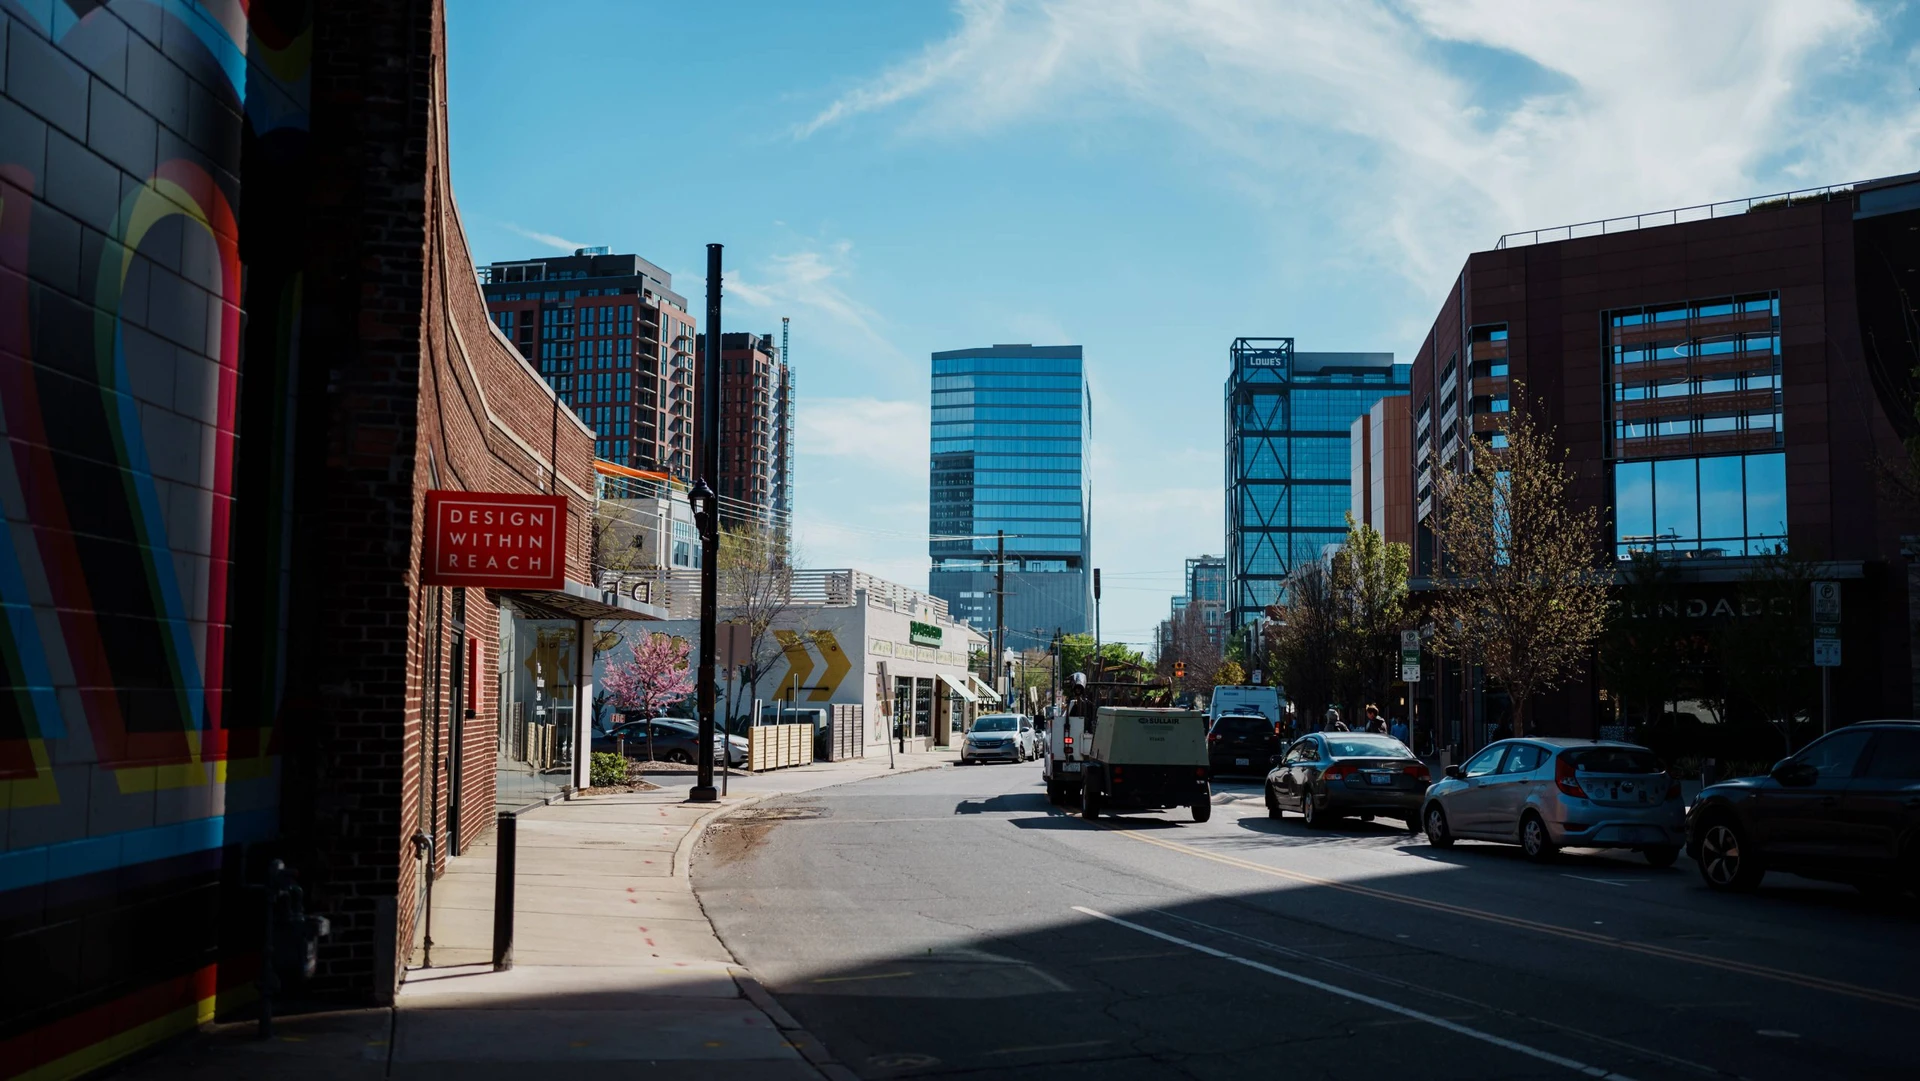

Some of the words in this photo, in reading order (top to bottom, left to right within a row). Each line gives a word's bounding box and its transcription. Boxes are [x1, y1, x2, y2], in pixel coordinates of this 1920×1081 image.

[1250, 356, 1281, 366] LOWE'S
[450, 509, 544, 526] DESIGN
[449, 532, 543, 549] WITHIN
[449, 554, 542, 570] REACH
[1149, 717, 1180, 725] SULLAIR
